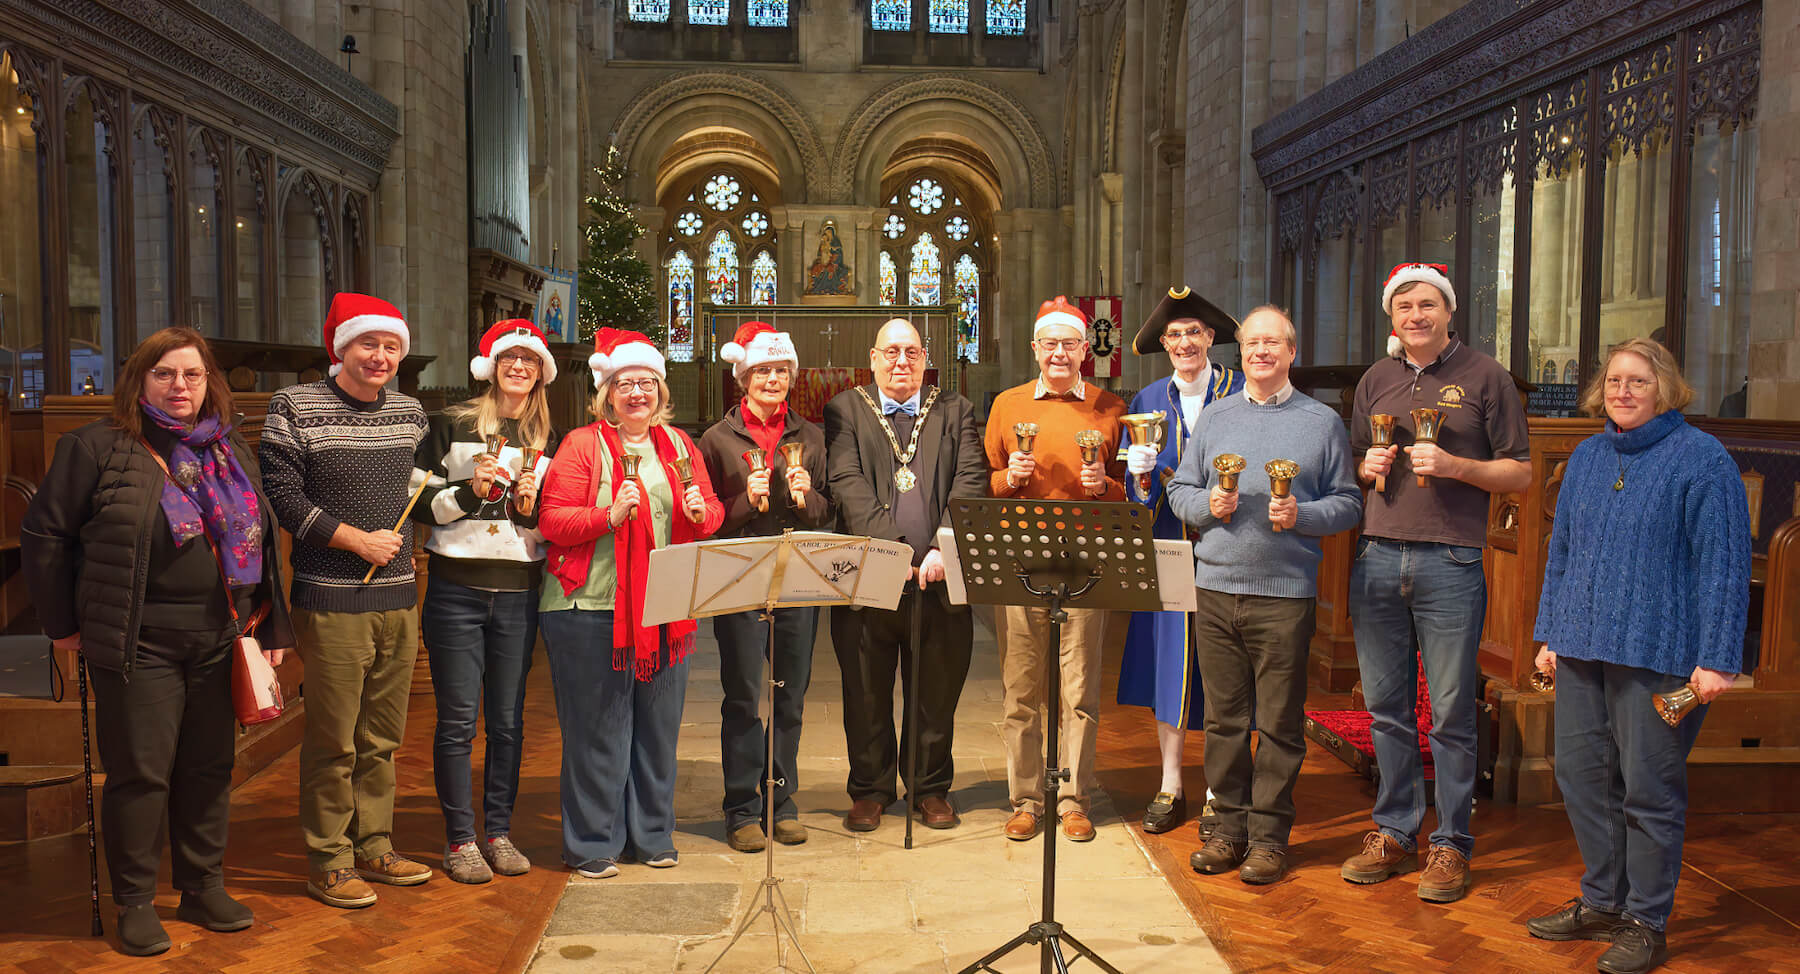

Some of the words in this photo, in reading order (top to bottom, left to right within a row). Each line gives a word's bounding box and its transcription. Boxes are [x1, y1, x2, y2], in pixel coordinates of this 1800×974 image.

[858, 545, 877, 553] AD
[877, 548, 899, 557] MORE
[1159, 548, 1184, 557] MORE
